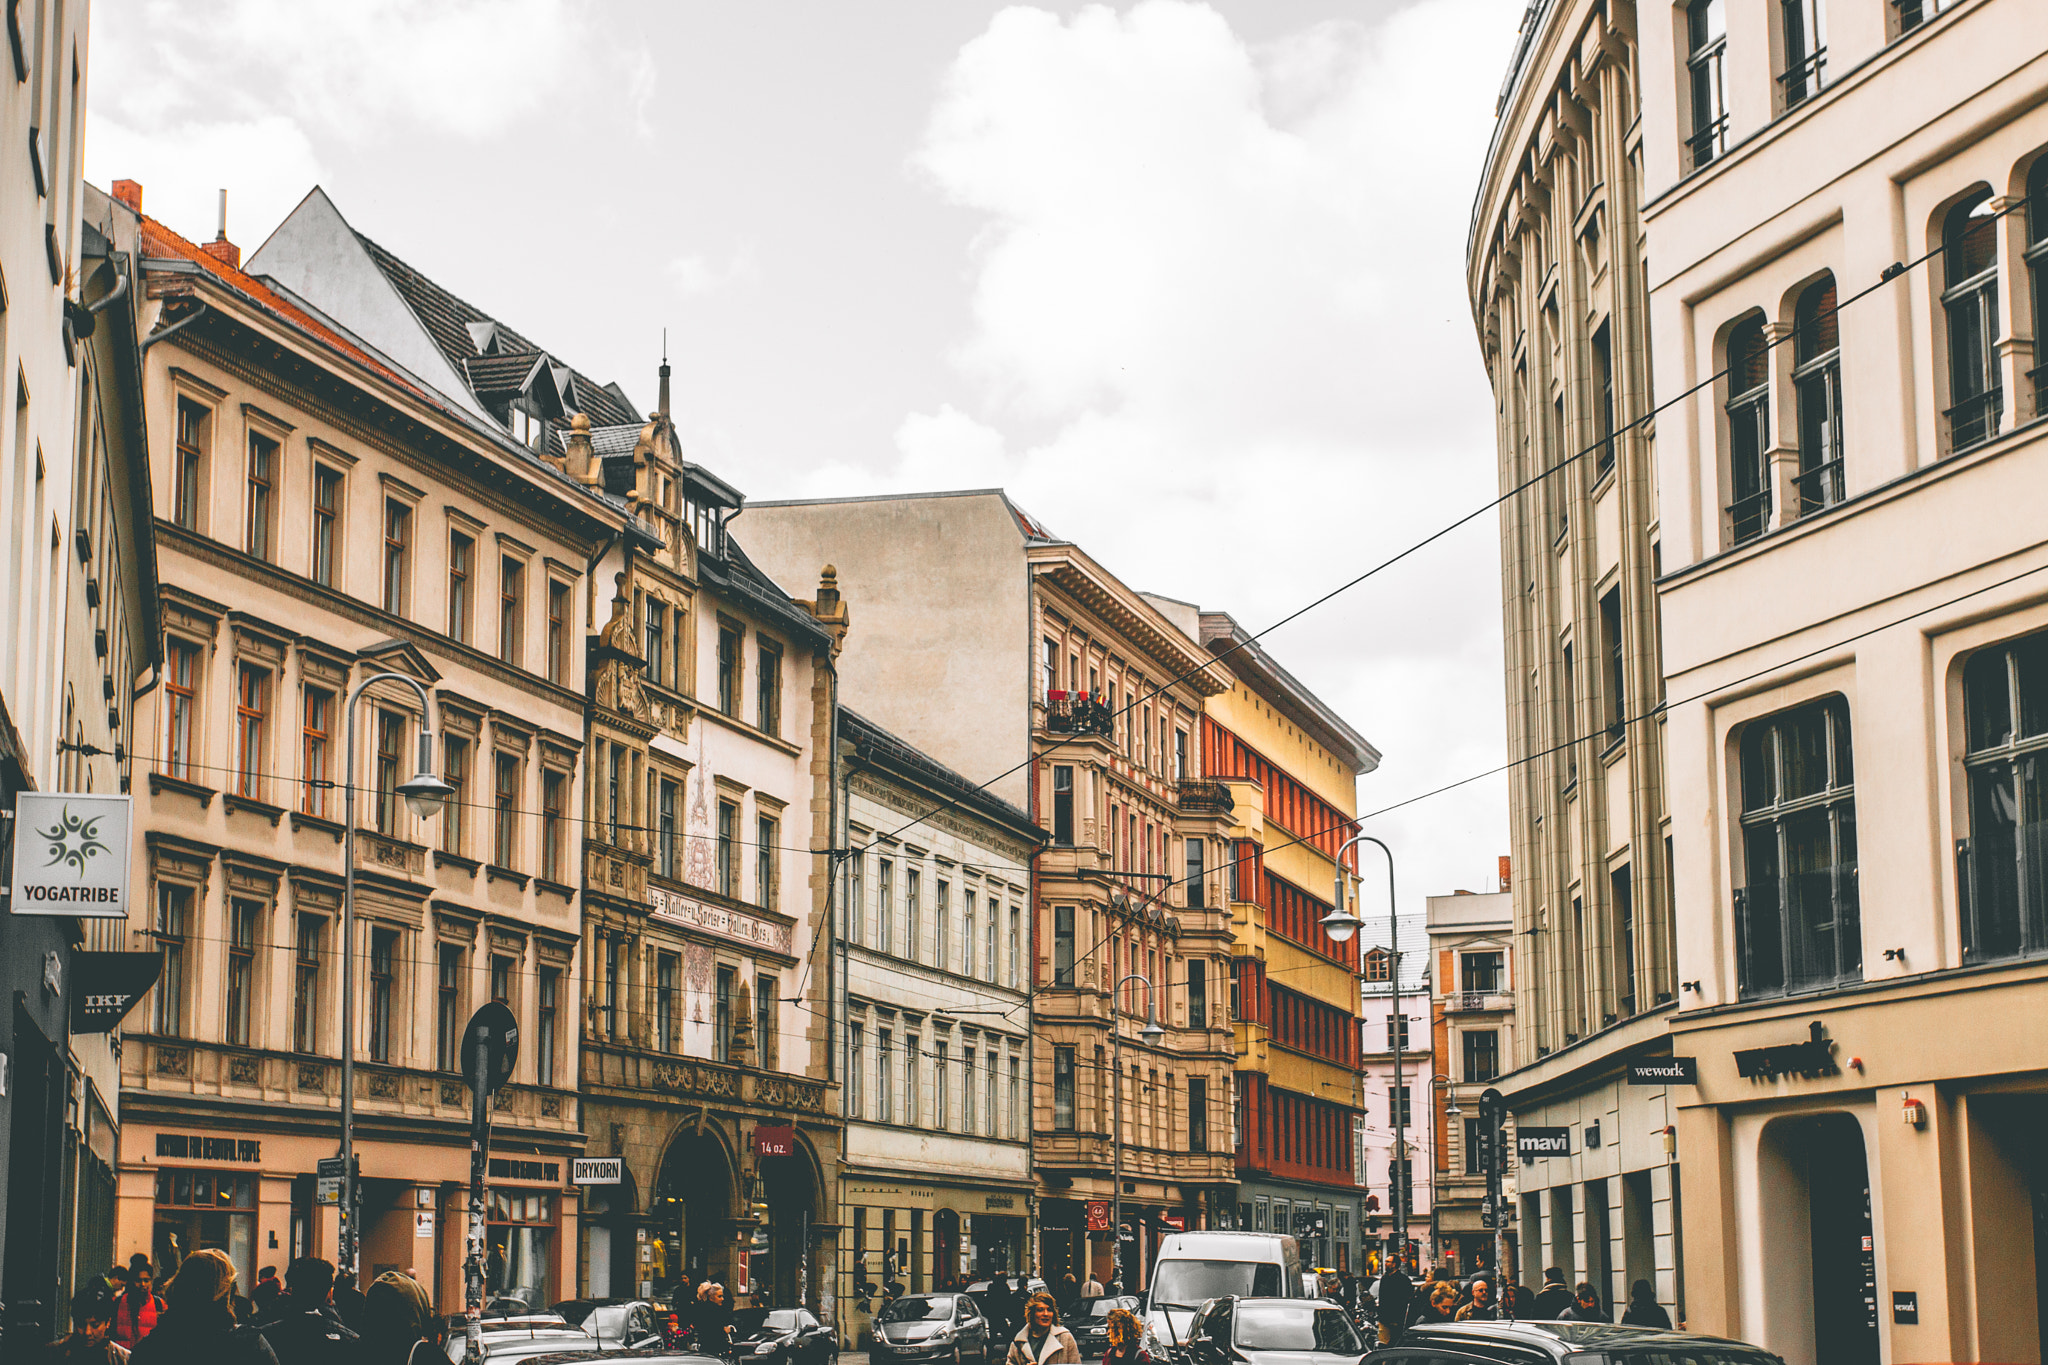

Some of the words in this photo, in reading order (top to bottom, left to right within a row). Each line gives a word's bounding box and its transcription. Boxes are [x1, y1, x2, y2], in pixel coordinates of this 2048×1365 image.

[24, 885, 119, 903] YOGATRIBE
[1635, 1063, 1685, 1077] wework
[761, 1141, 772, 1153] 14
[773, 1144, 787, 1154] oz.
[1519, 1133, 1567, 1151] mavi
[575, 1162, 619, 1179] DRYKORN
